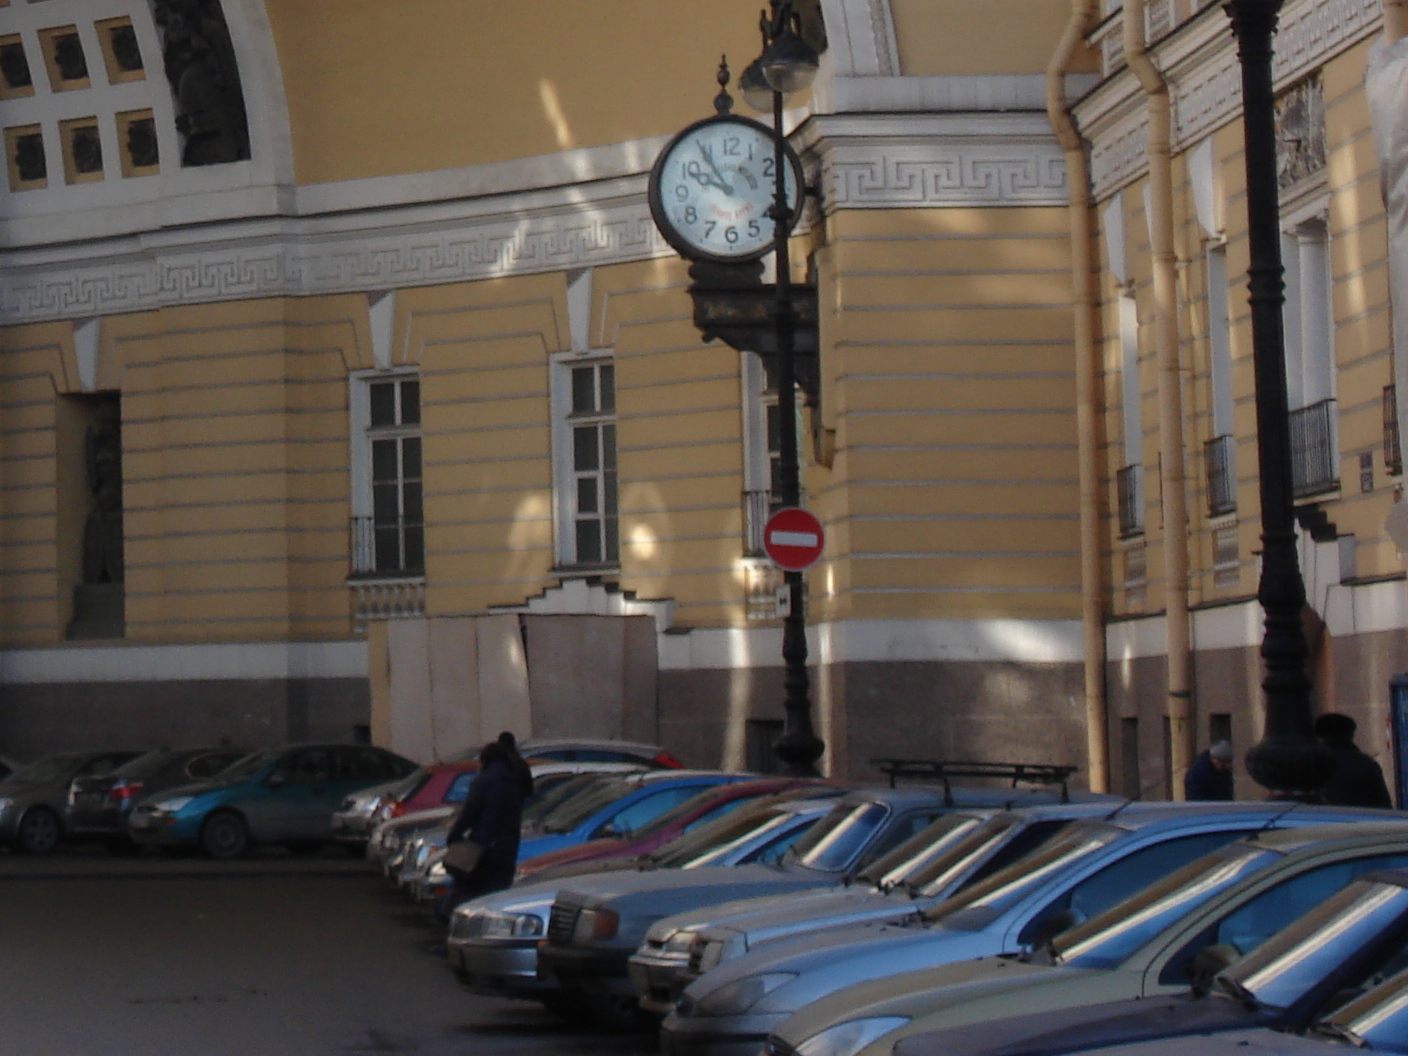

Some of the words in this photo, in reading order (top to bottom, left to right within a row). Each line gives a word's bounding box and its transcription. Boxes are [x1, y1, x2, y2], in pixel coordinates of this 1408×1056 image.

[723, 137, 741, 156] 12
[682, 161, 701, 179] 10
[762, 158, 774, 177] 2
[675, 185, 689, 202] 9
[686, 206, 698, 224] 8
[704, 221, 717, 238] 7
[725, 226, 739, 243] 6
[748, 220, 760, 237] 5
